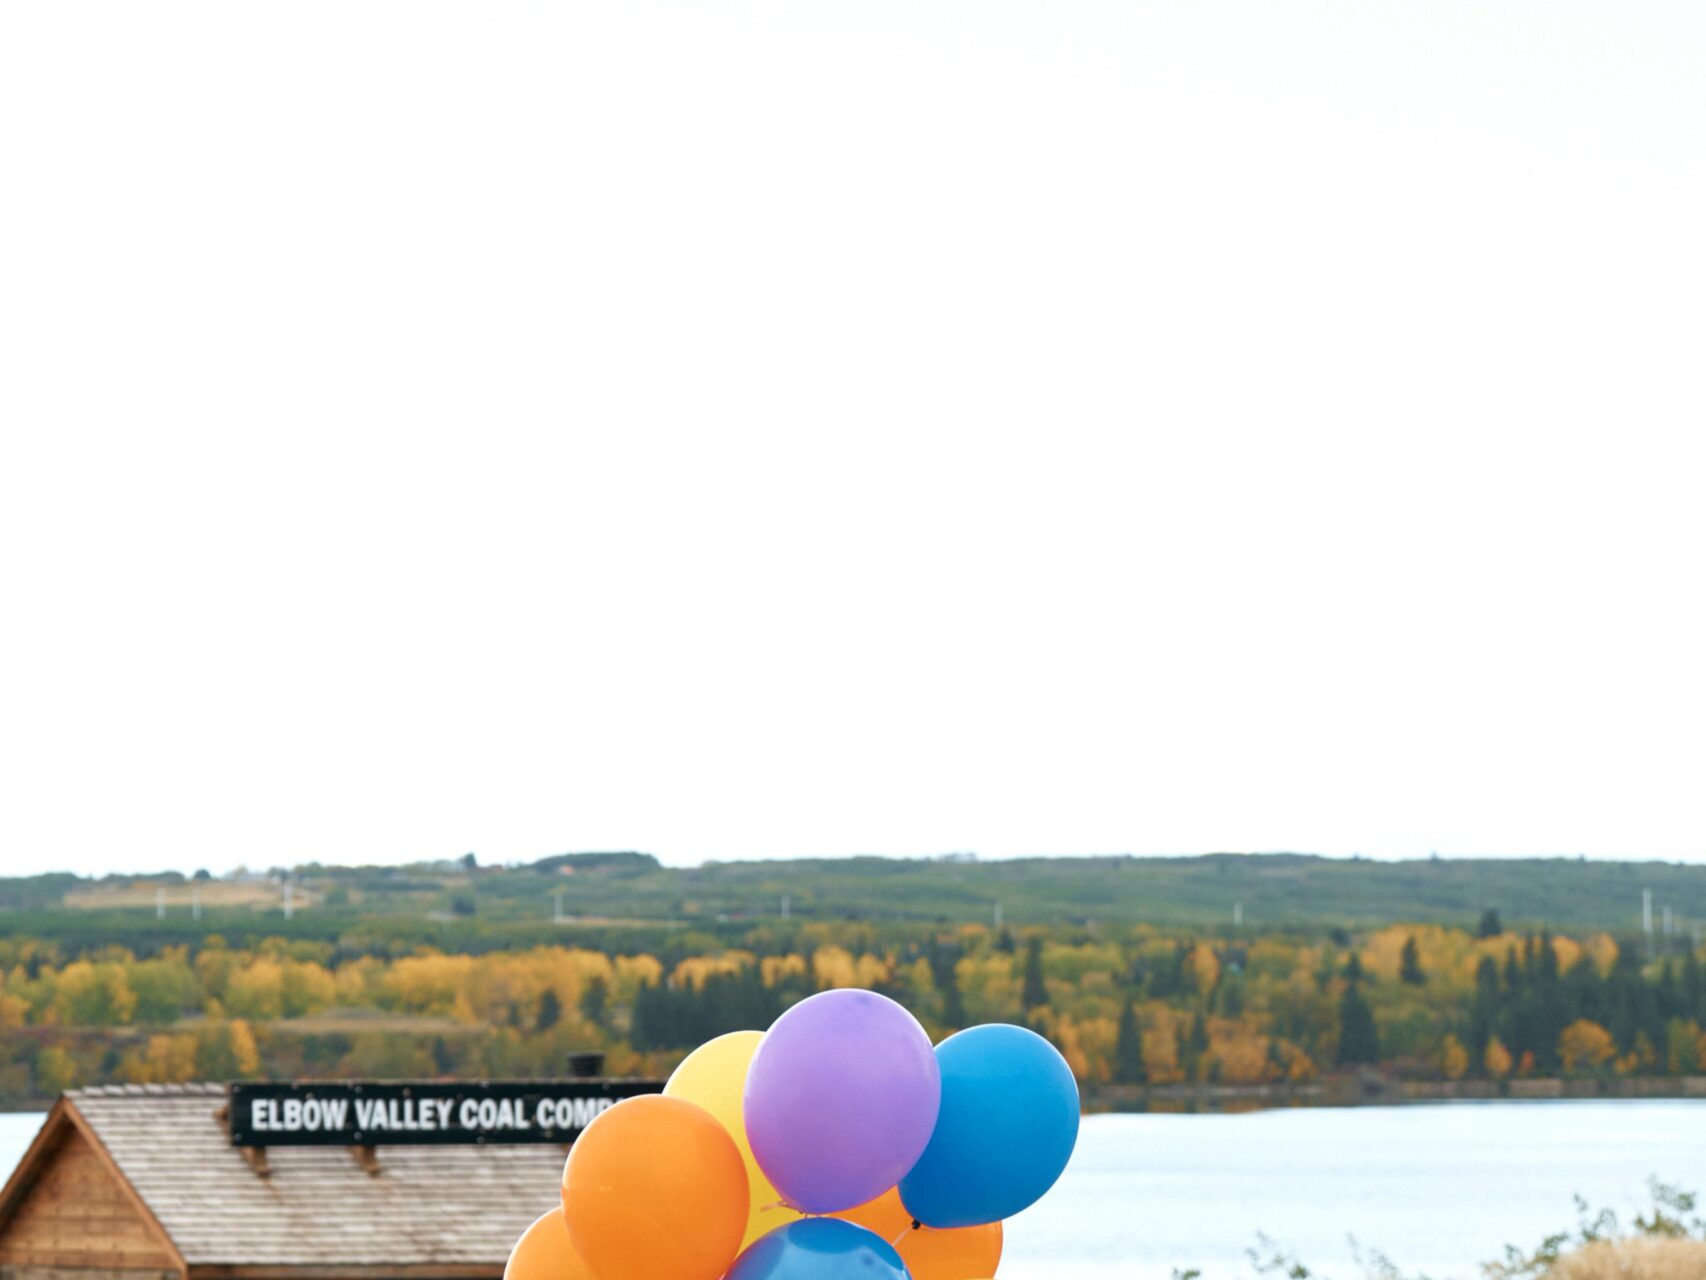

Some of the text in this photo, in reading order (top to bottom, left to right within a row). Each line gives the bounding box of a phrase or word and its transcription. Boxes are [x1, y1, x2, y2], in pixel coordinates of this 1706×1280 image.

[252, 1097, 624, 1131] ELBOW VALLEY COAL COM
